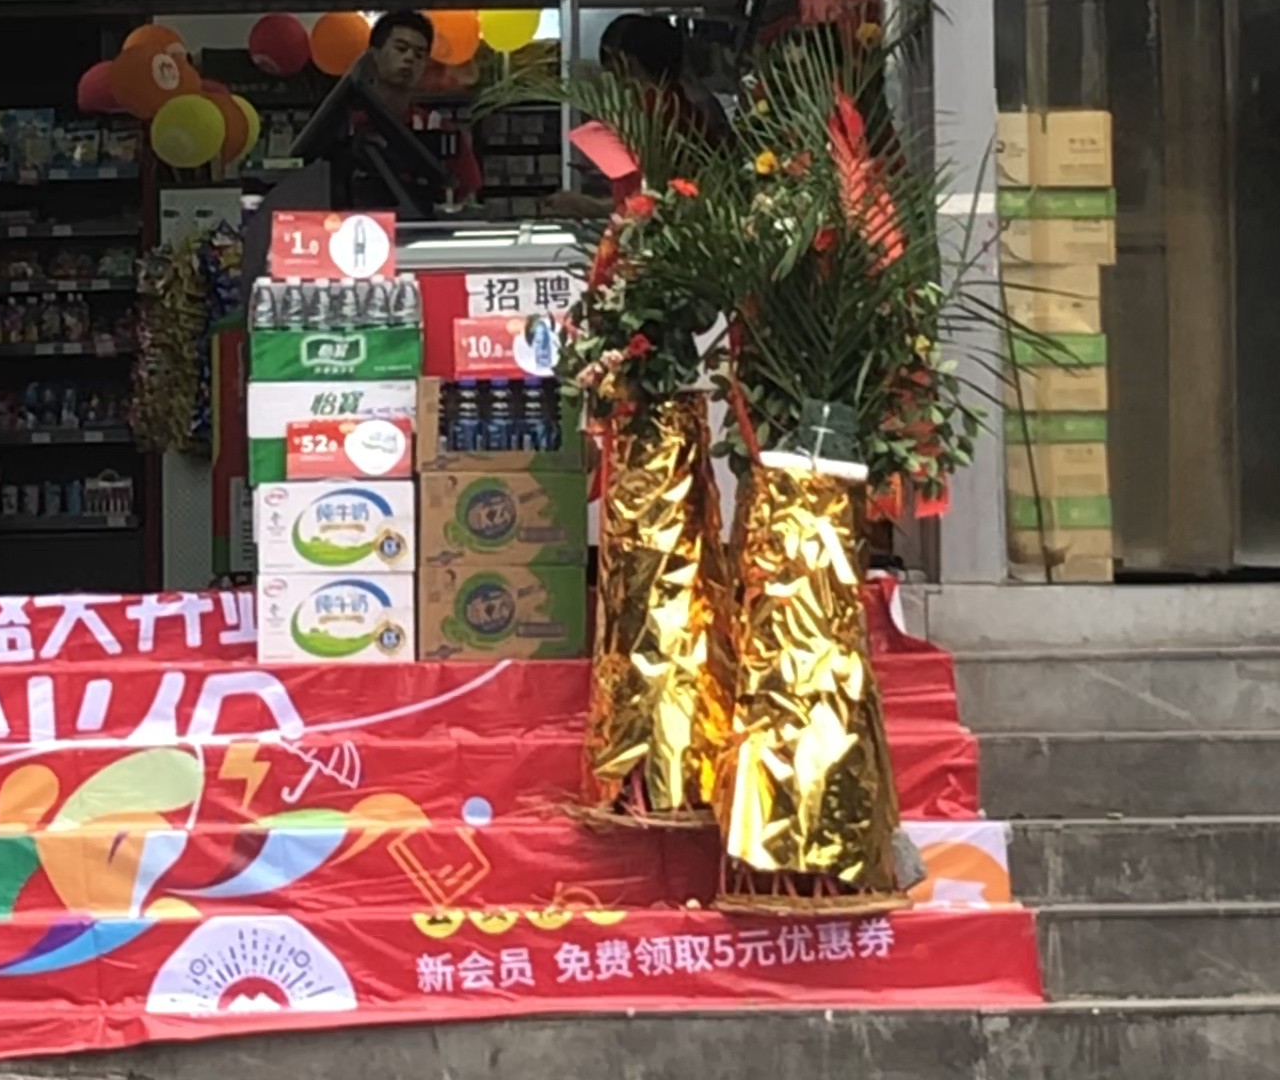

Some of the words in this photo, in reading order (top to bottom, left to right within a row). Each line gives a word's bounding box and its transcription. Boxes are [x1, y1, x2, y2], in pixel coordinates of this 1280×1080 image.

[484, 274, 571, 313] 招聘
[415, 947, 535, 994] 新会员
[555, 916, 896, 986] 免费领取5元优惠券
